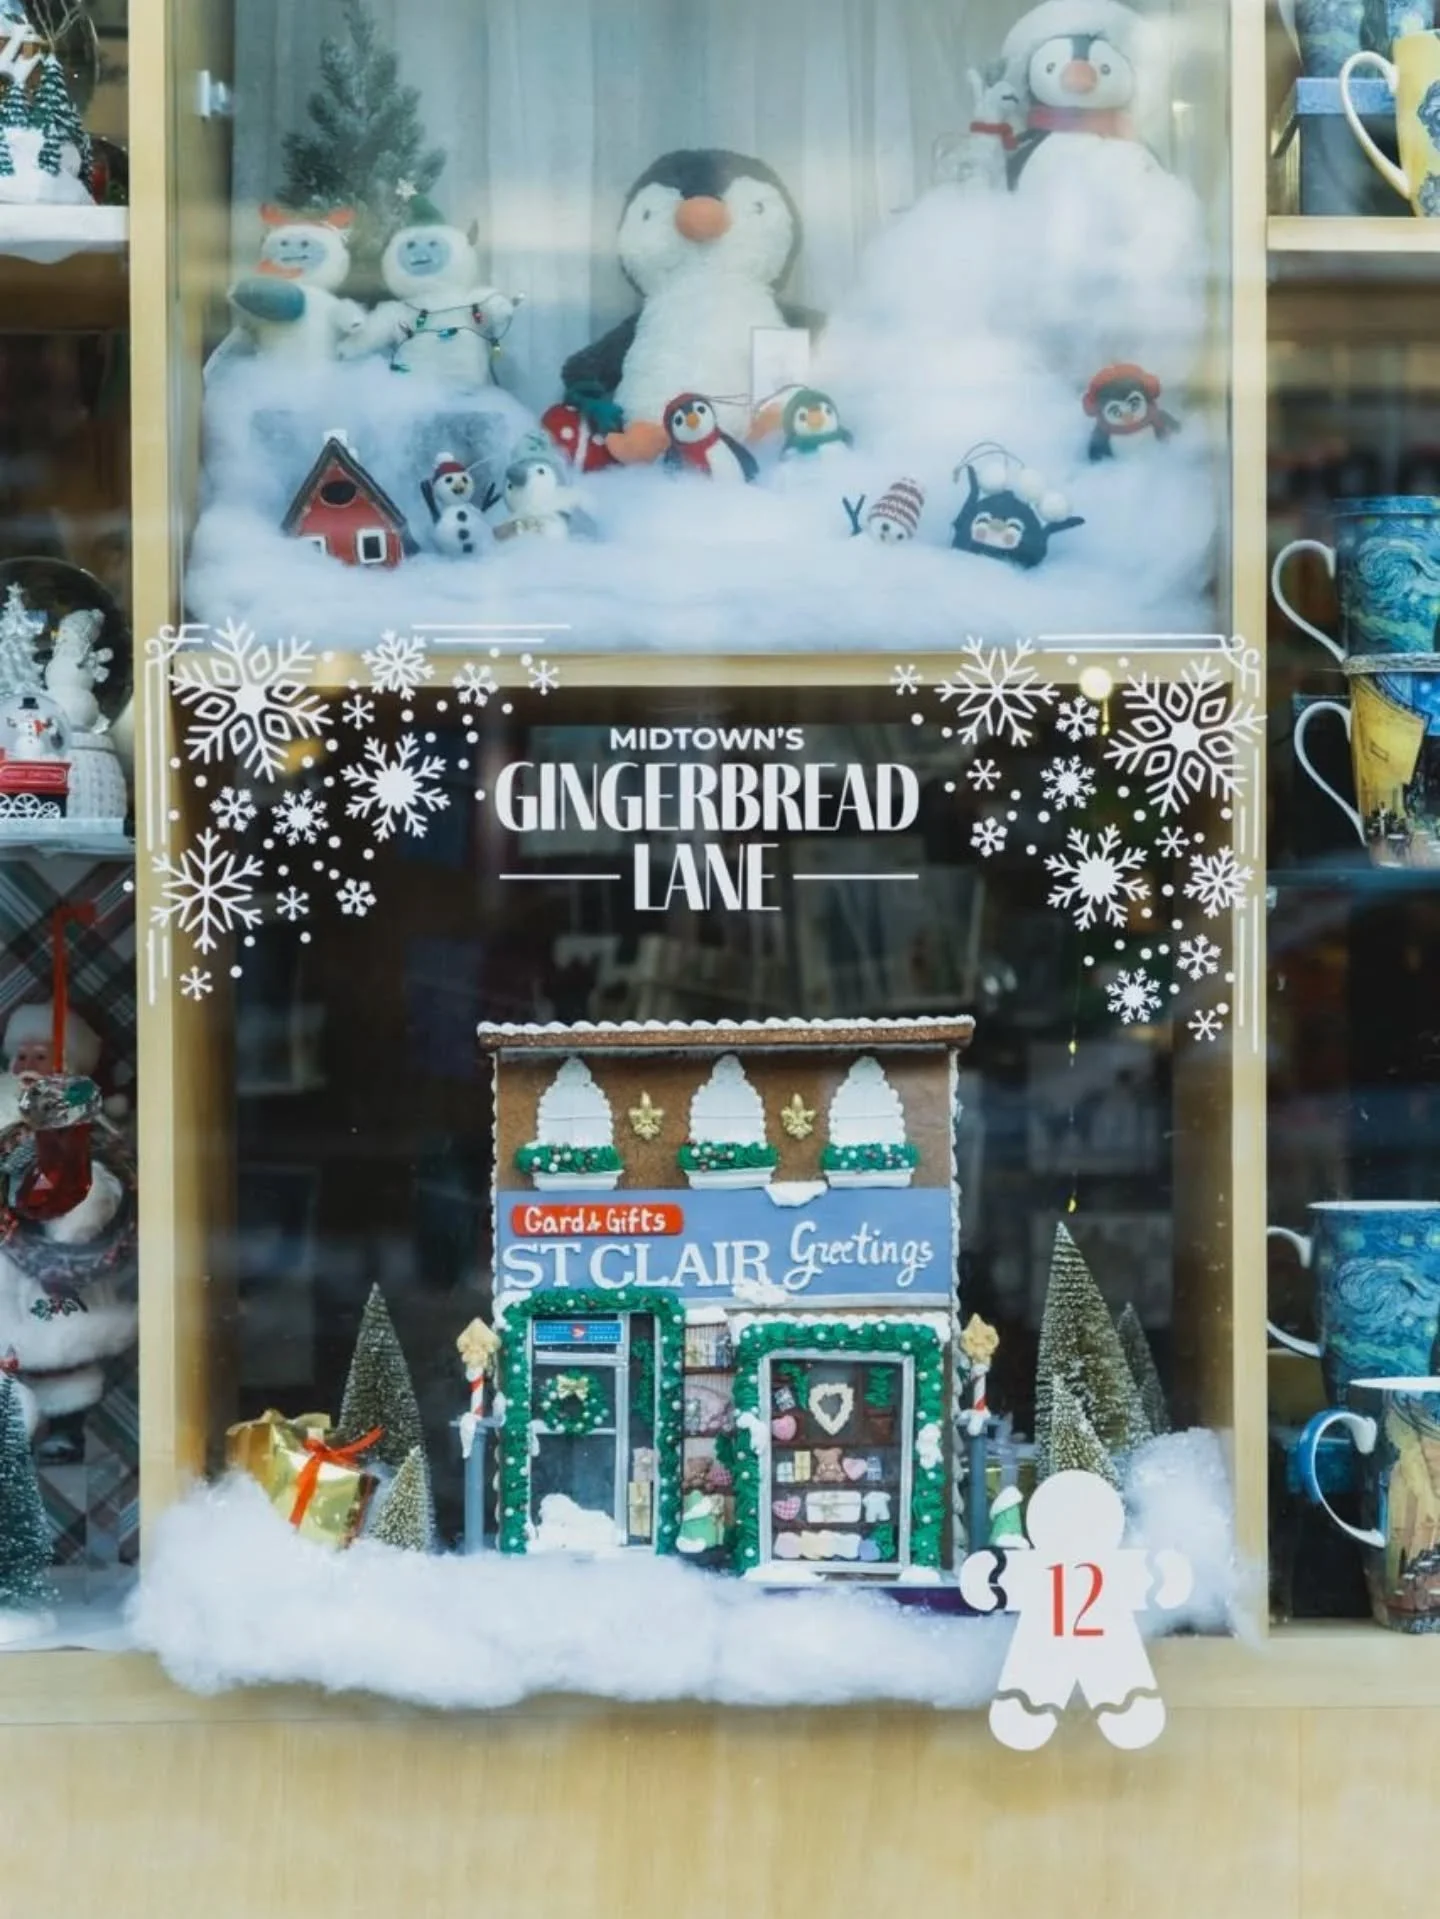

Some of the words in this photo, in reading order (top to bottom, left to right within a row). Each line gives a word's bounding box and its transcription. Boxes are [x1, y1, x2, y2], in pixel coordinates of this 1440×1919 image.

[610, 727, 805, 751] MIDTOWN'S
[495, 762, 919, 831] GINGERBREAD
[634, 843, 781, 911] LANE
[606, 1207, 667, 1234] Gifts
[502, 1243, 582, 1289] ST
[589, 1243, 773, 1290] CLAIR
[783, 1220, 934, 1290] Greetings
[1045, 1562, 1104, 1637] 12
